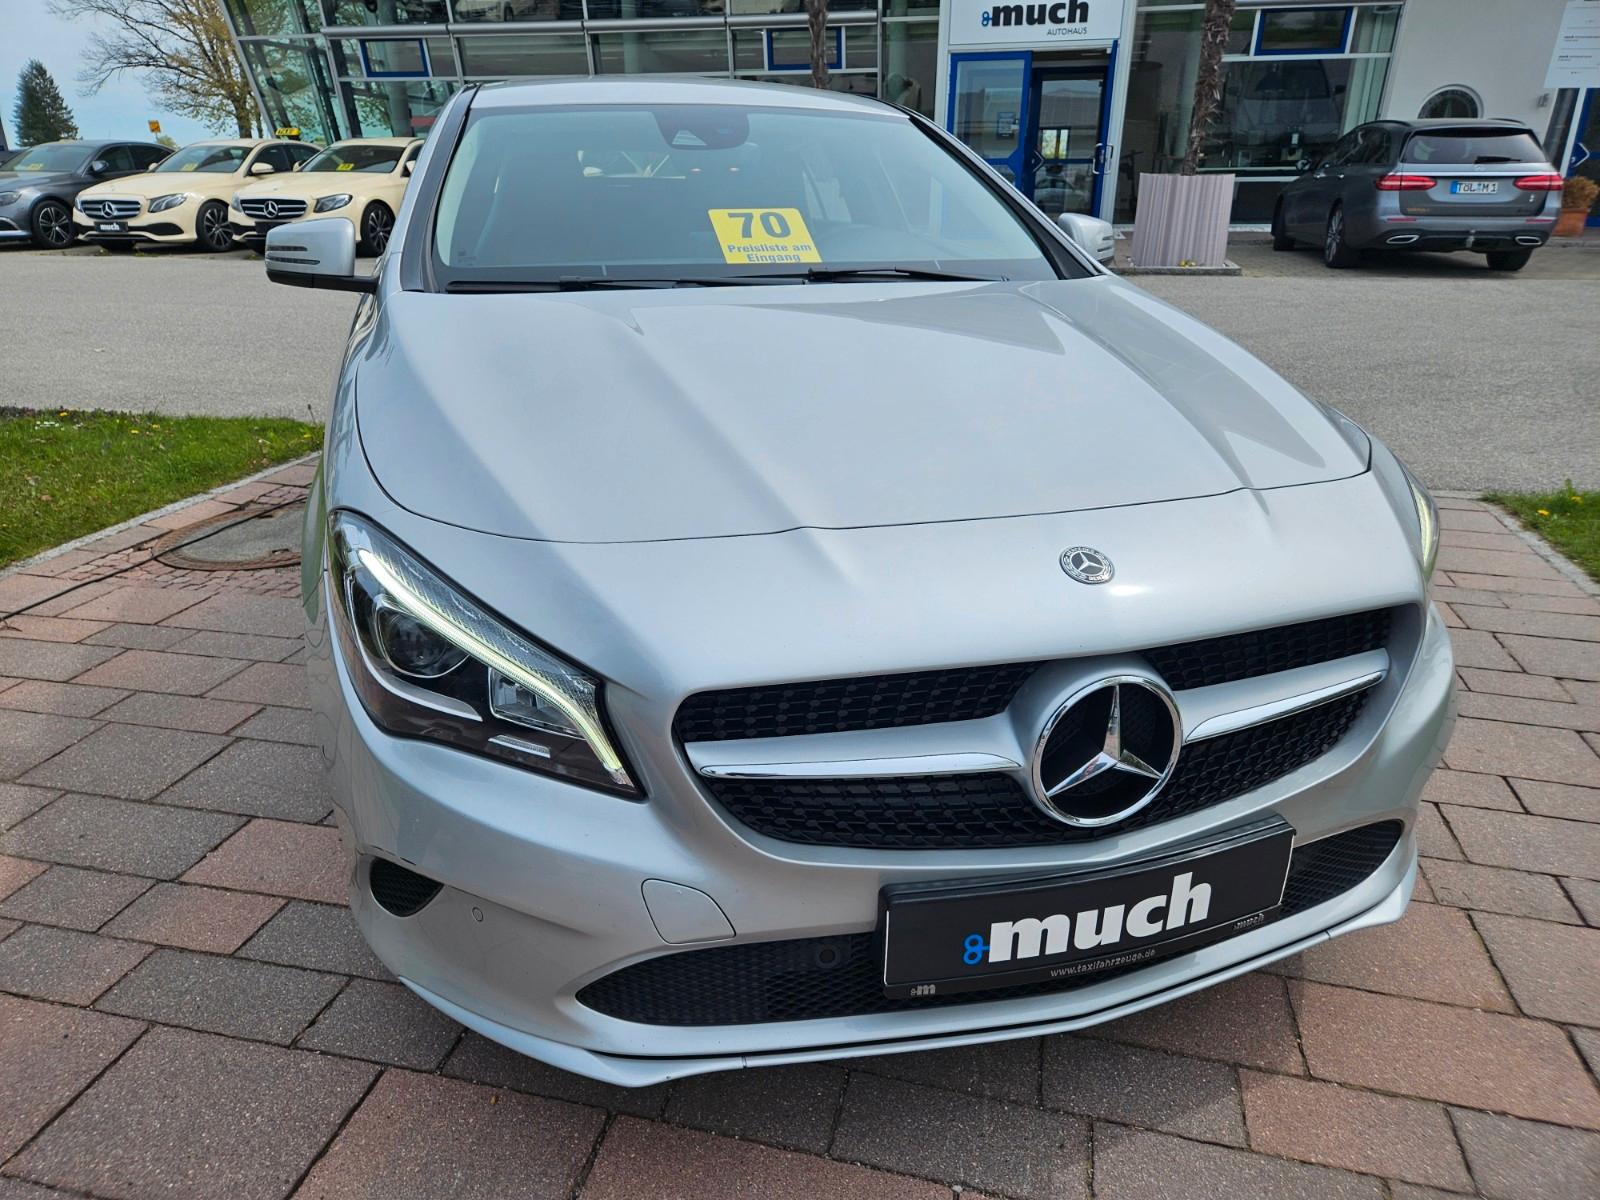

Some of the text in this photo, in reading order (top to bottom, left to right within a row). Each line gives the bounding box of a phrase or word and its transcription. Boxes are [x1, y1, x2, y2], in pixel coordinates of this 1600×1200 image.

[992, 0, 1089, 26] much
[1047, 27, 1088, 36] AUTOHAUS
[100, 222, 120, 231] much
[727, 211, 791, 239] 70
[727, 244, 789, 253] Preisliste
[747, 253, 800, 263] Eingang
[988, 871, 1212, 963] much
[1050, 949, 1156, 977] www.taxifahrzeuge.de
